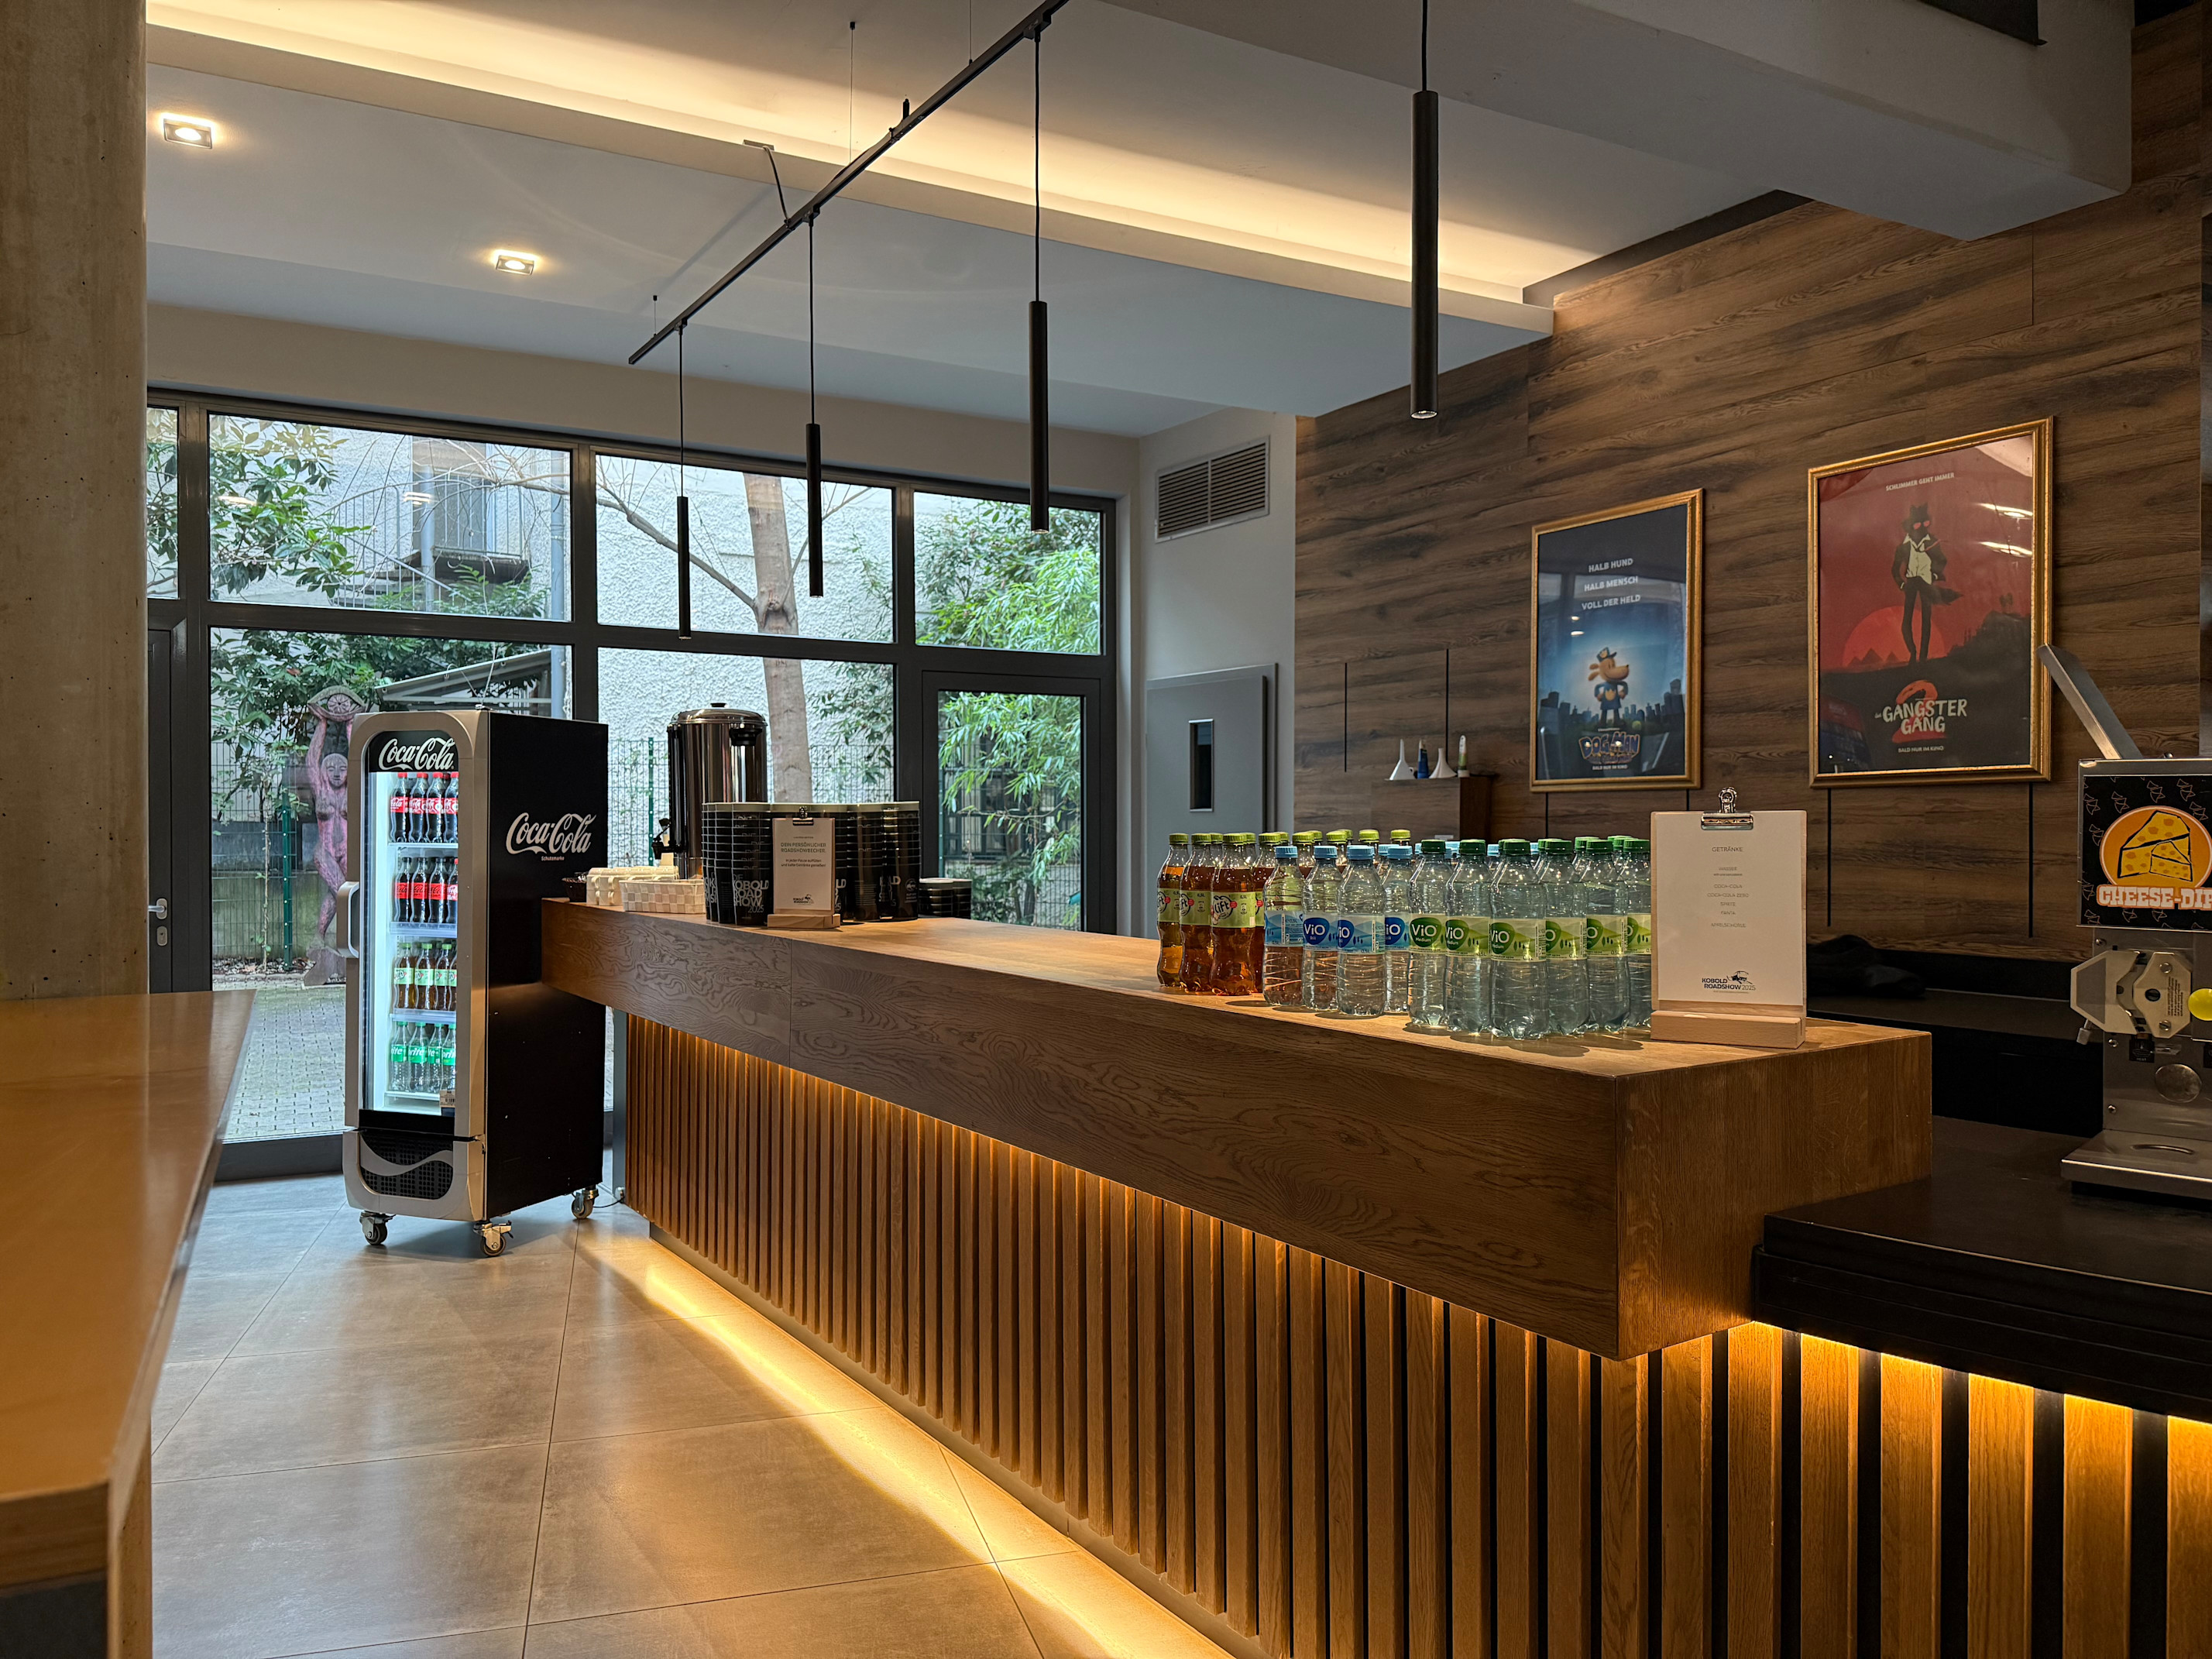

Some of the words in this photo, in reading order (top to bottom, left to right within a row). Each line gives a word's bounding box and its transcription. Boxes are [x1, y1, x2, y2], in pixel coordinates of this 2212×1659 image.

[1886, 479, 1918, 492] SCHLIMMER
[1918, 476, 1934, 485] GEHT
[1935, 472, 1955, 482] IMMER
[1588, 562, 1609, 572] HALB
[1610, 558, 1633, 568] HUND
[1584, 582, 1605, 592] HALB
[1606, 575, 1638, 588] MENSCH
[1582, 601, 1602, 610] VOLL
[1603, 597, 1619, 607] DER
[1620, 594, 1641, 604] HELD
[1882, 699, 1967, 723] GANGSTER
[1901, 716, 1946, 735] GANG
[379, 737, 455, 771] Coca-Cola
[1578, 736, 1609, 759] DOG
[506, 812, 597, 854] Coca-Cola
[2099, 886, 2212, 909] CHEESE-DIP
[747, 905, 764, 913] 2025
[1214, 901, 1230, 913] Lift
[1304, 923, 1326, 936] ViO
[1338, 927, 1351, 939] iO
[1386, 924, 1401, 936] iO
[1411, 924, 1437, 937] ViO
